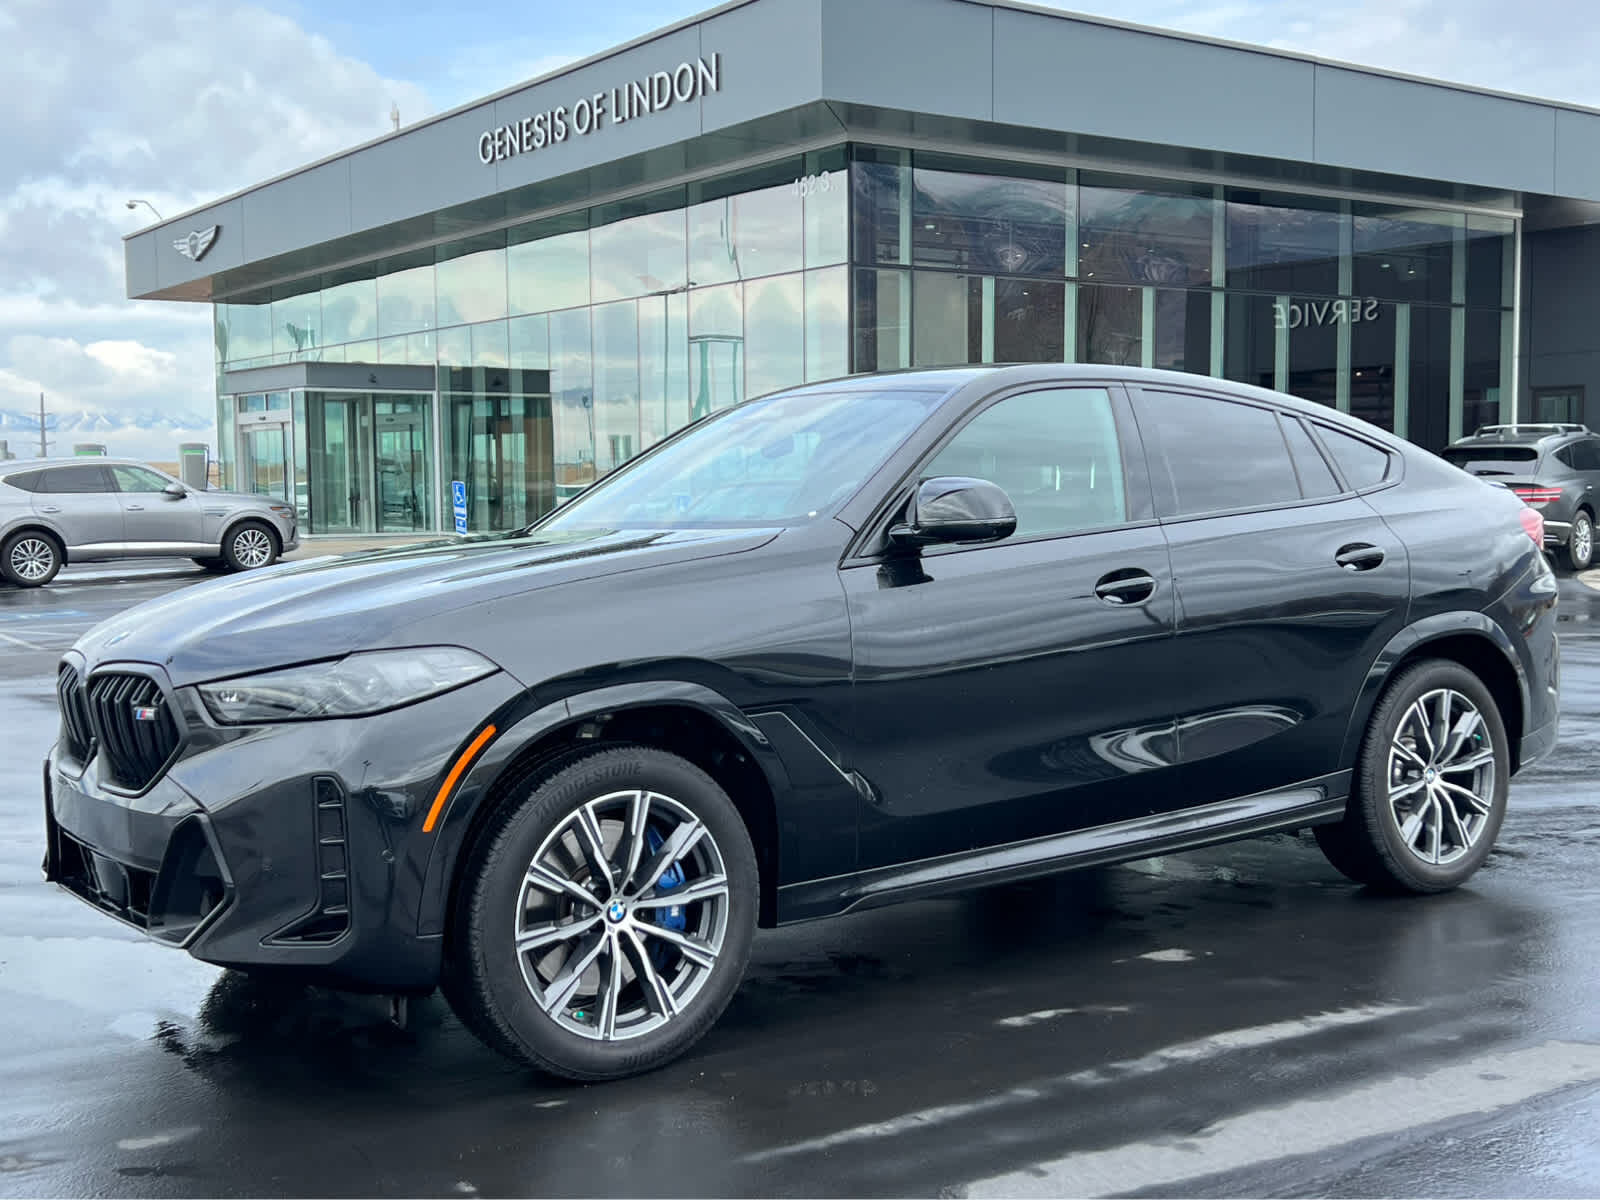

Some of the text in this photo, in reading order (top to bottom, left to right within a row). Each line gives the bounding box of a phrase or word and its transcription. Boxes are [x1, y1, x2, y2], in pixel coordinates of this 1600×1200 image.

[478, 52, 720, 164] GENESIS OF LINDON
